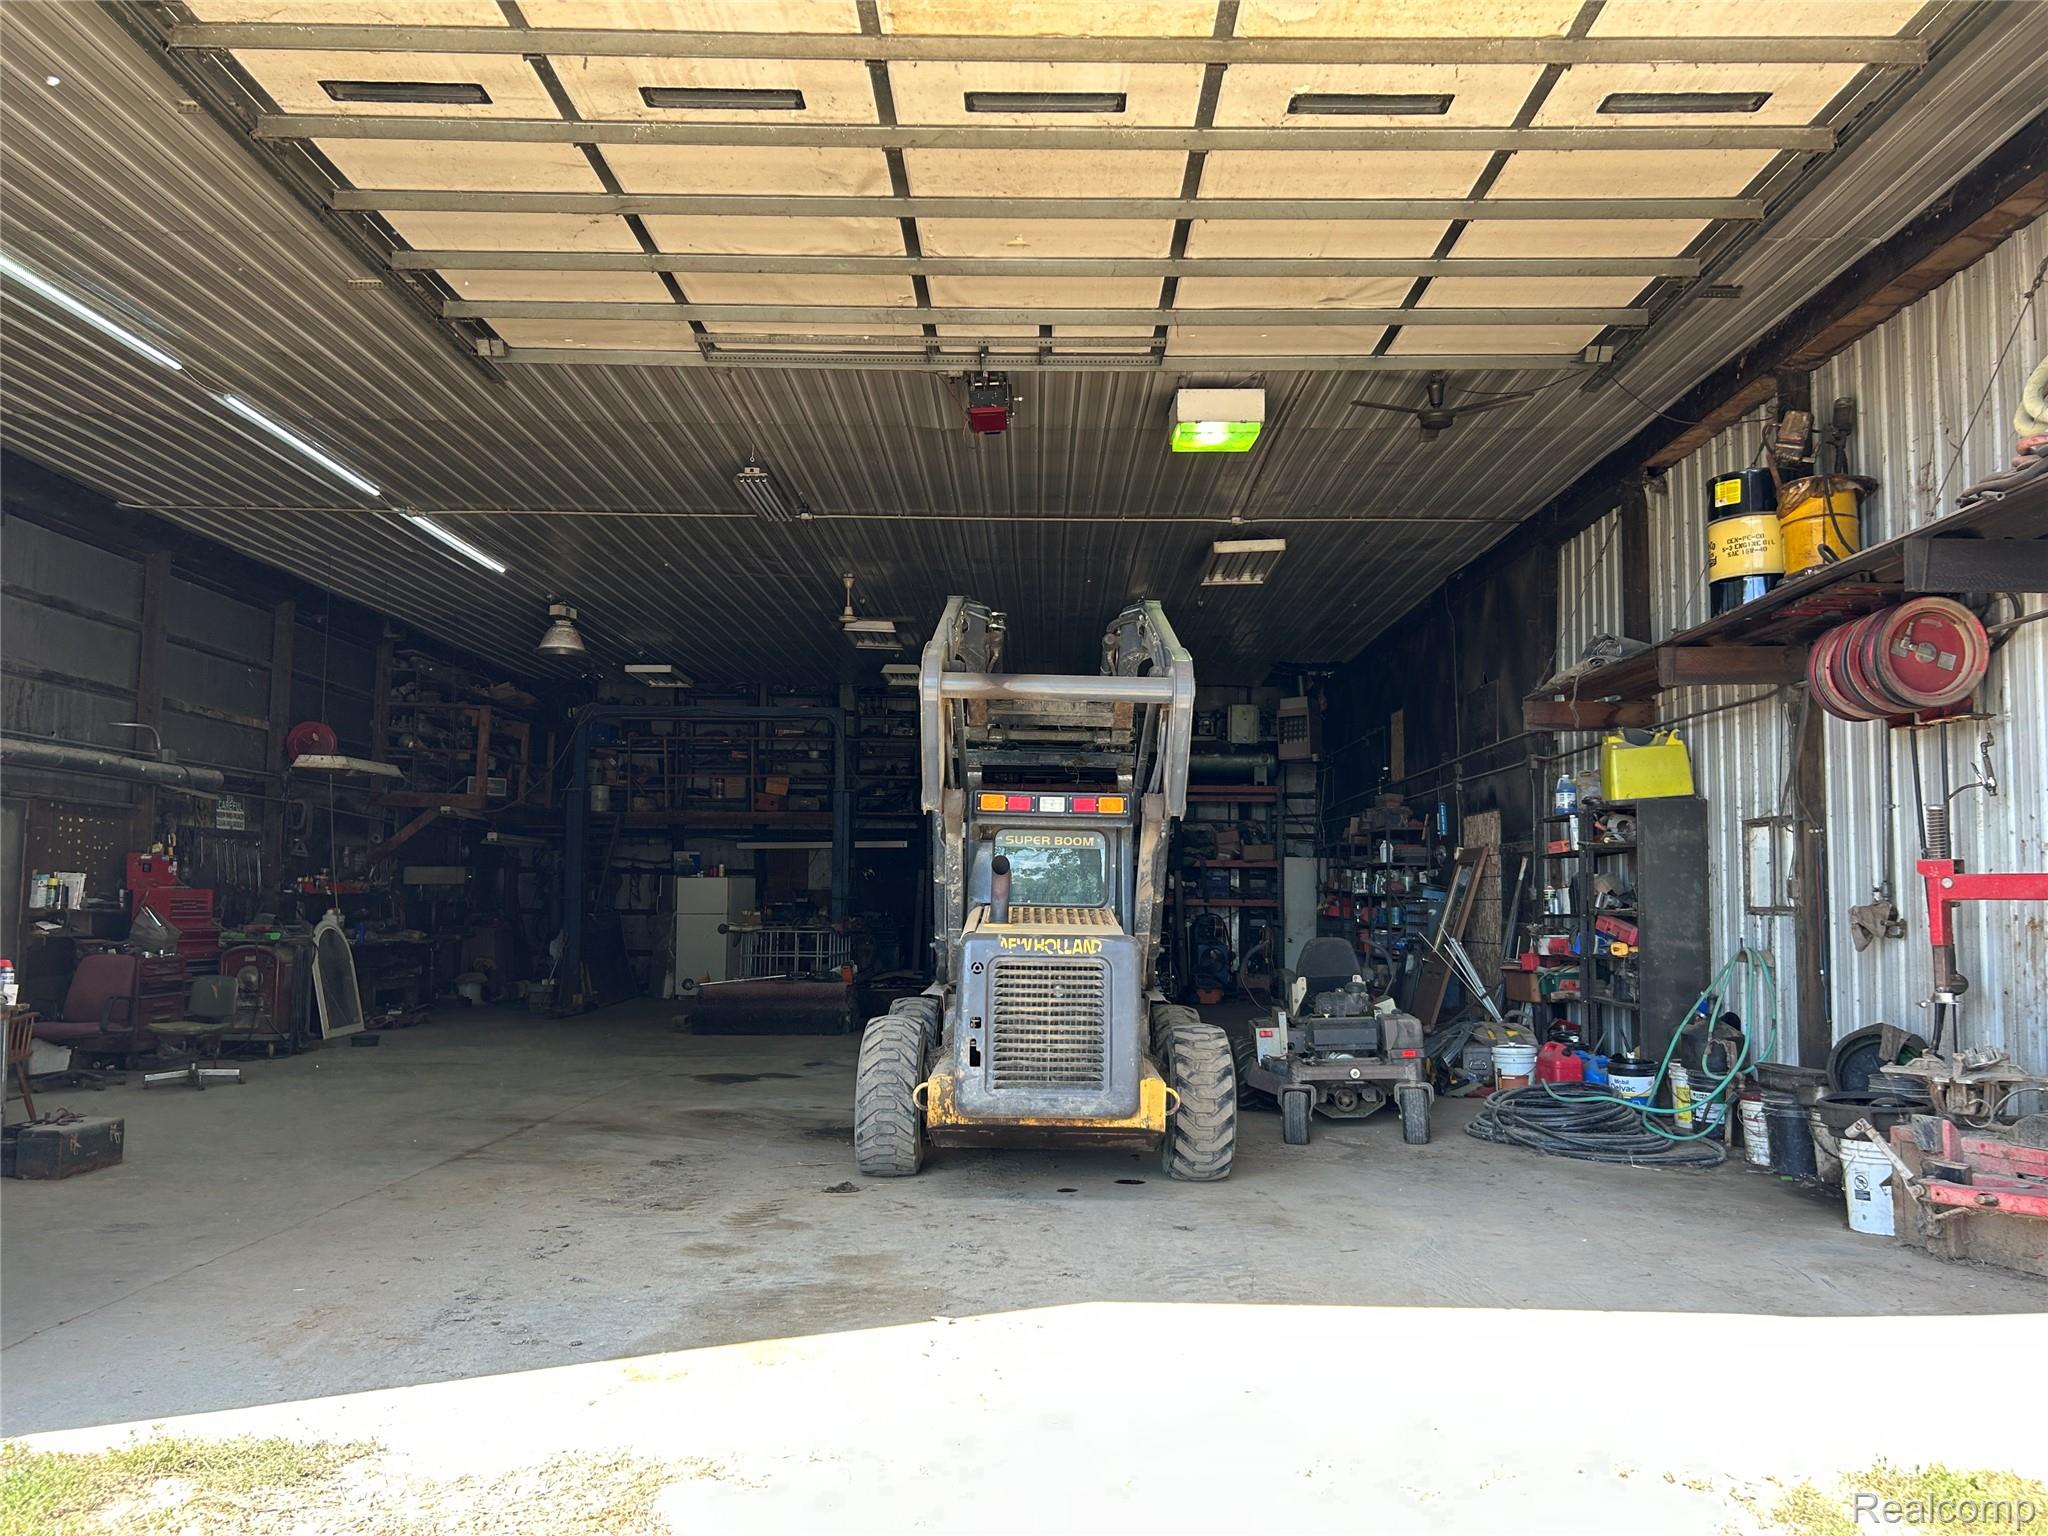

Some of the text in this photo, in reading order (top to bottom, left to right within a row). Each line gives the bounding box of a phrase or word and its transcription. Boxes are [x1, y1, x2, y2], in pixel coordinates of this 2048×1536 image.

[1734, 540, 1761, 550] ENGINE
[1005, 835, 1095, 846] SUPER BOOM
